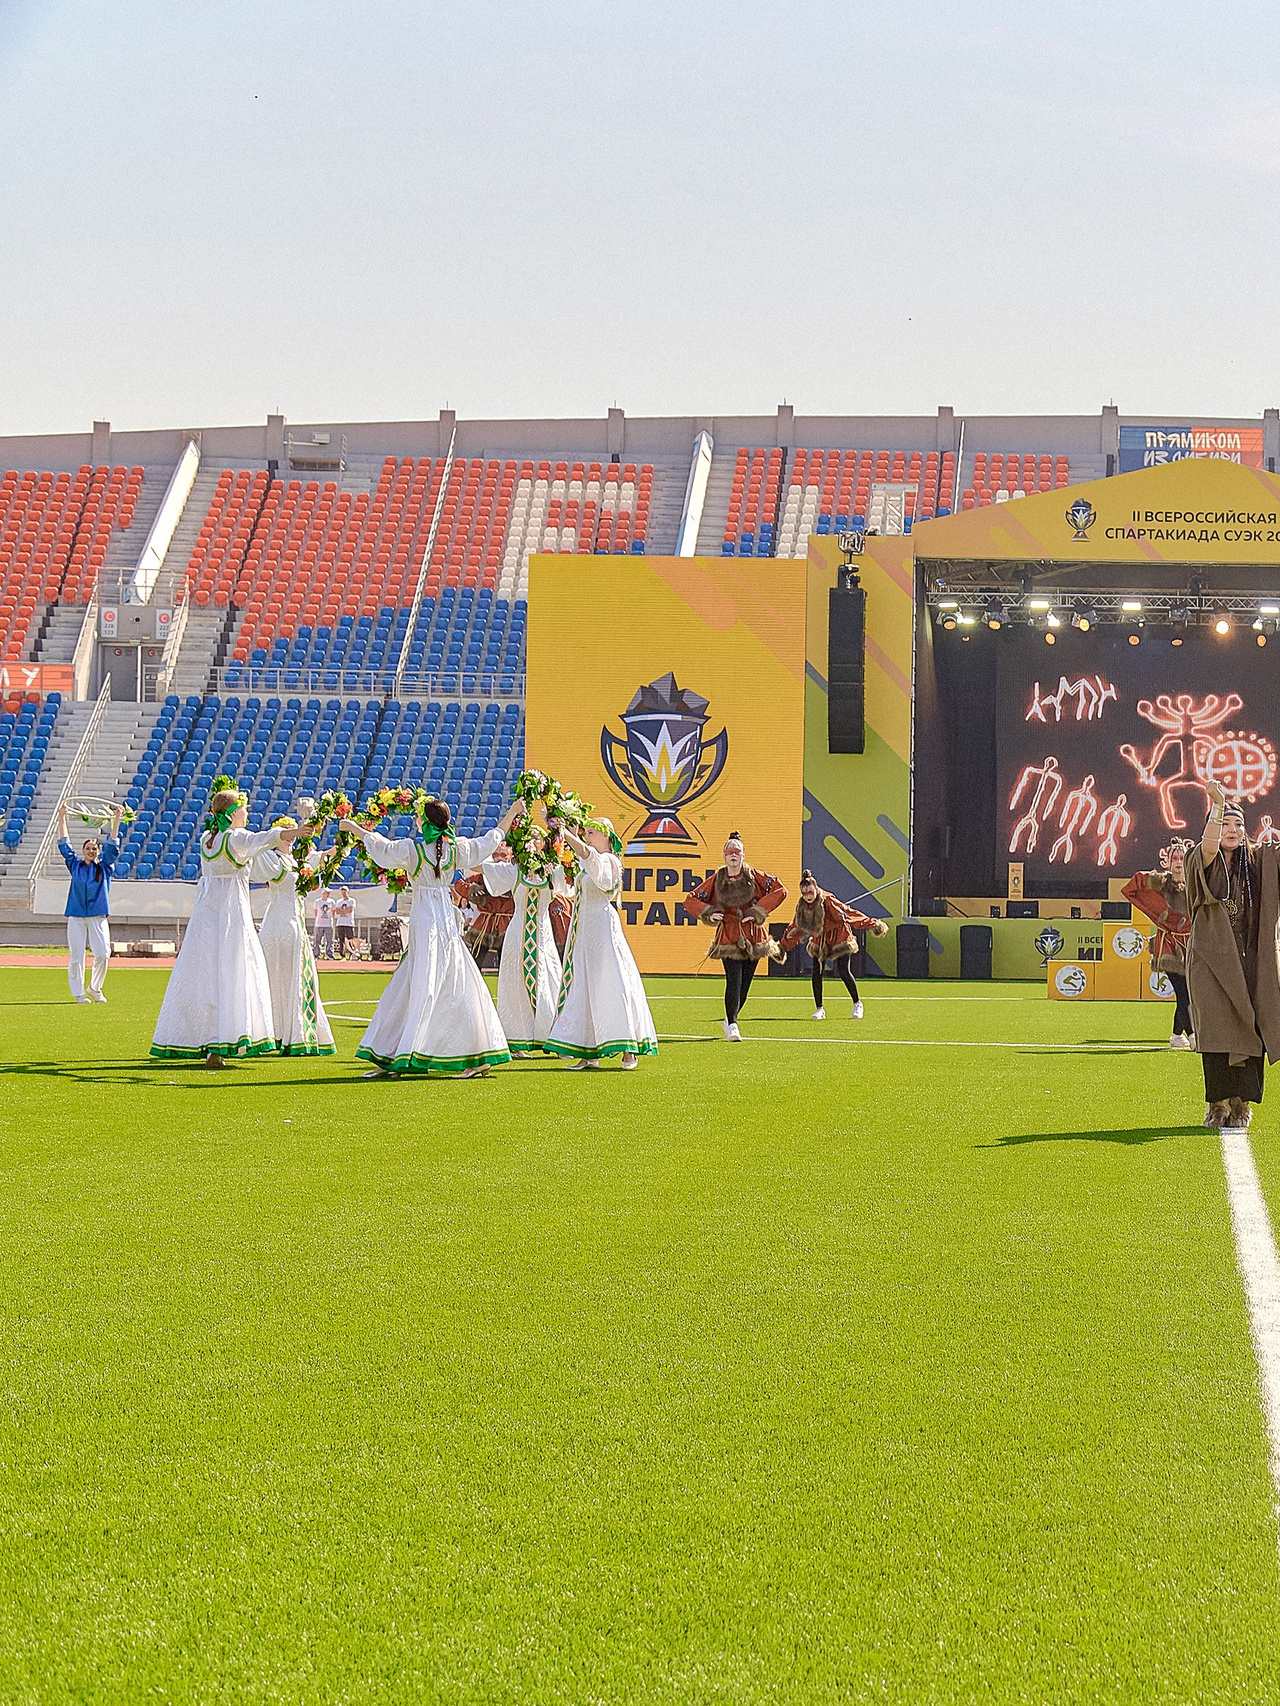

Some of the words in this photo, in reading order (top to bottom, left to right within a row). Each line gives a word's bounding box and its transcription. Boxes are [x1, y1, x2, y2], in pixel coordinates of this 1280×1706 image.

[1145, 431, 1241, 449] ПРЯМИКОМ
[1143, 450, 1169, 466] ИЗ
[1145, 509, 1277, 524] ВСЕРОССИЙСКАЯ
[1105, 527, 1220, 543] СПАРТАКИАДА
[1223, 530, 1264, 543] СУЭК
[611, 901, 697, 926] ТАН
